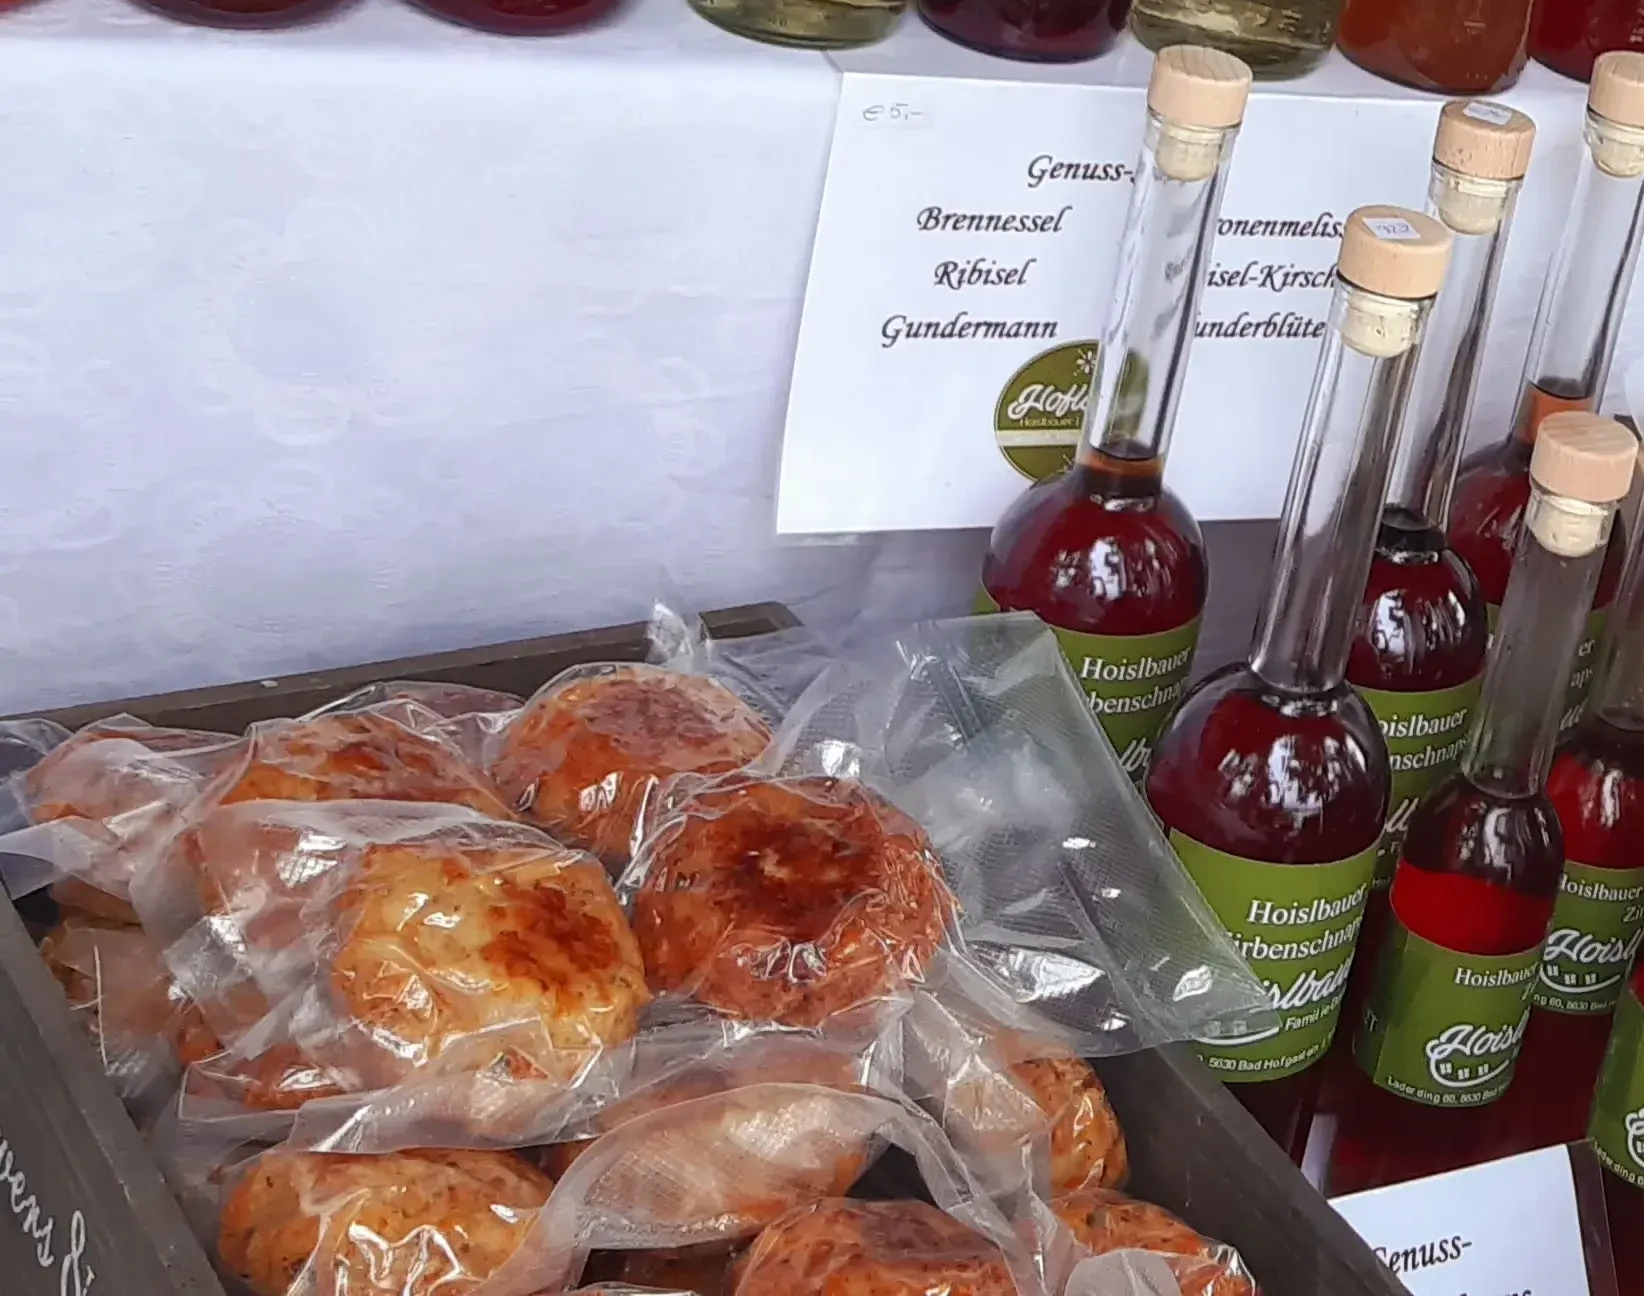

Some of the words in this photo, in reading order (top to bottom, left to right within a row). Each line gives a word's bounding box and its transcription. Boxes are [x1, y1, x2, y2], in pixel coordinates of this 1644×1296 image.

[1026, 153, 1136, 189] Genuss-
[915, 204, 1074, 233] Brennessel
[932, 257, 1038, 291] Ribisel
[1206, 259, 1338, 293] isel-Kirsch
[880, 310, 1059, 349] Gundermann
[1080, 646, 1192, 681] Hoislbauer
[1246, 883, 1368, 926] Hoislbauer
[1237, 1057, 1261, 1072] Bad
